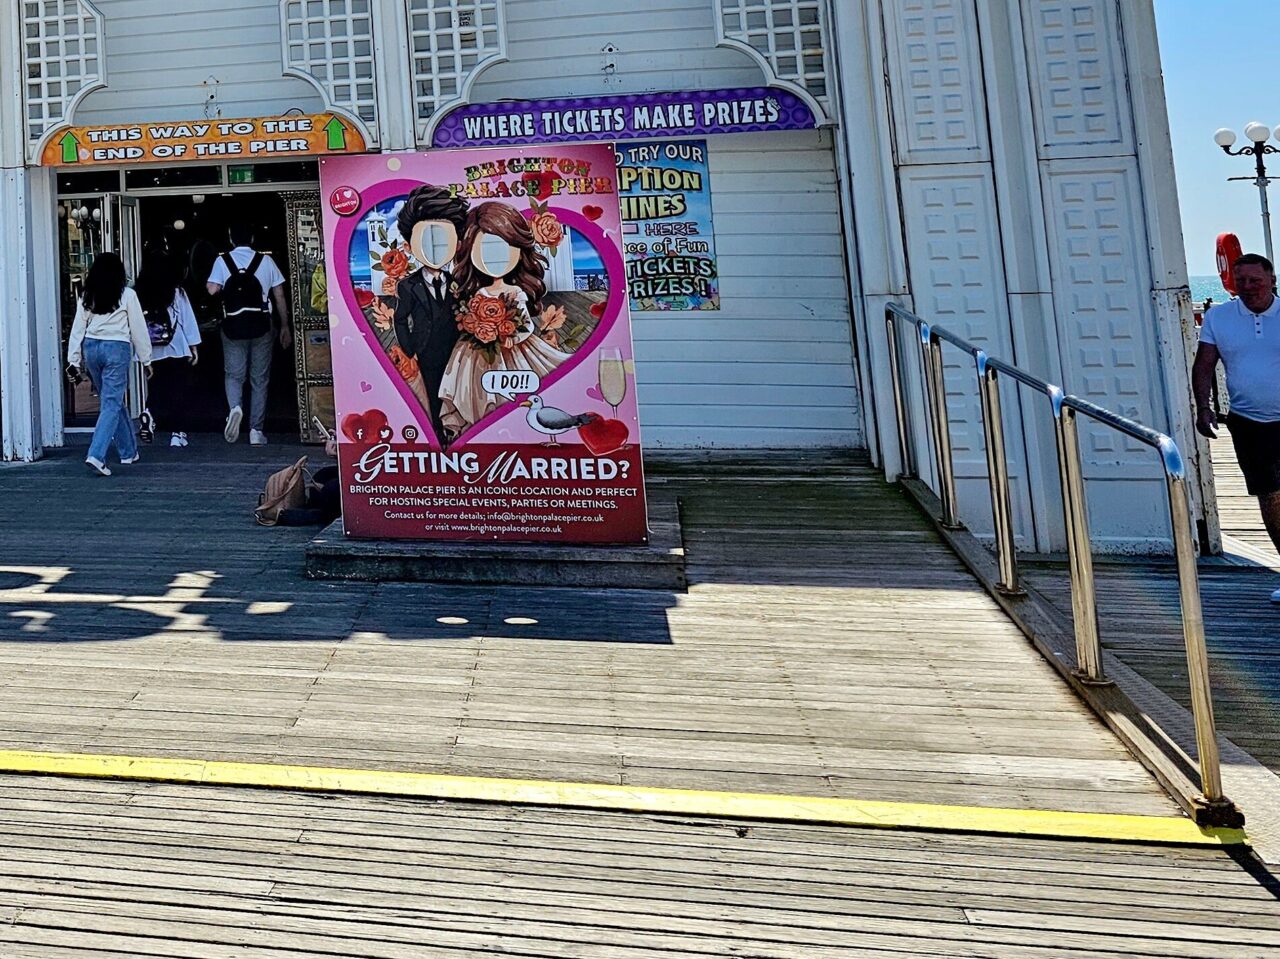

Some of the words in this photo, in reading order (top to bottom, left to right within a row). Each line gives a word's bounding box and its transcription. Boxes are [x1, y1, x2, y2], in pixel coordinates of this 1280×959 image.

[463, 113, 535, 139] WHERE
[541, 107, 625, 135] TICKETS
[633, 102, 695, 131] MAKE
[703, 98, 779, 128] PRIZES
[88, 127, 142, 143] THIS
[149, 123, 210, 139] WAY
[217, 121, 255, 136] TO
[263, 119, 312, 133] THE
[92, 147, 144, 161] END
[152, 144, 186, 157] OF
[194, 141, 242, 156] THE
[250, 139, 309, 153] PIER
[628, 144, 660, 163] TRY
[665, 144, 703, 162] OUR
[464, 157, 592, 182] BRIGHTON
[448, 179, 540, 199] PALACE
[551, 177, 614, 195] PIER
[645, 222, 699, 236] HERE
[652, 237, 672, 255] of
[675, 237, 709, 254] Fun
[626, 257, 712, 278] TICKETS
[491, 374, 496, 389] I
[500, 374, 529, 389] DO!!
[352, 443, 479, 483] GETTING
[463, 450, 630, 484] MARRIED?
[350, 485, 397, 494] BRIGHTON
[400, 485, 435, 494] PALACE
[436, 486, 456, 494] PIER
[458, 486, 466, 494] IS
[468, 486, 481, 494] AN
[483, 486, 519, 495] ICONIC
[520, 487, 569, 495] LOCATION
[571, 487, 593, 496] AND
[595, 488, 637, 496] PERFECT
[369, 497, 388, 506] FOR
[390, 497, 431, 506] HOSTING
[433, 498, 470, 506] SPECIAL
[472, 499, 510, 508] EVENTS,
[511, 499, 548, 508] PARTIES
[550, 500, 565, 508] OR
[567, 500, 618, 509] MEETINGS.
[384, 510, 414, 519] Contact
[425, 511, 436, 519] for
[487, 511, 604, 523] info@brightonpalacepier.co.uk
[451, 523, 562, 534] www.brightonpalacepier.co.uk
